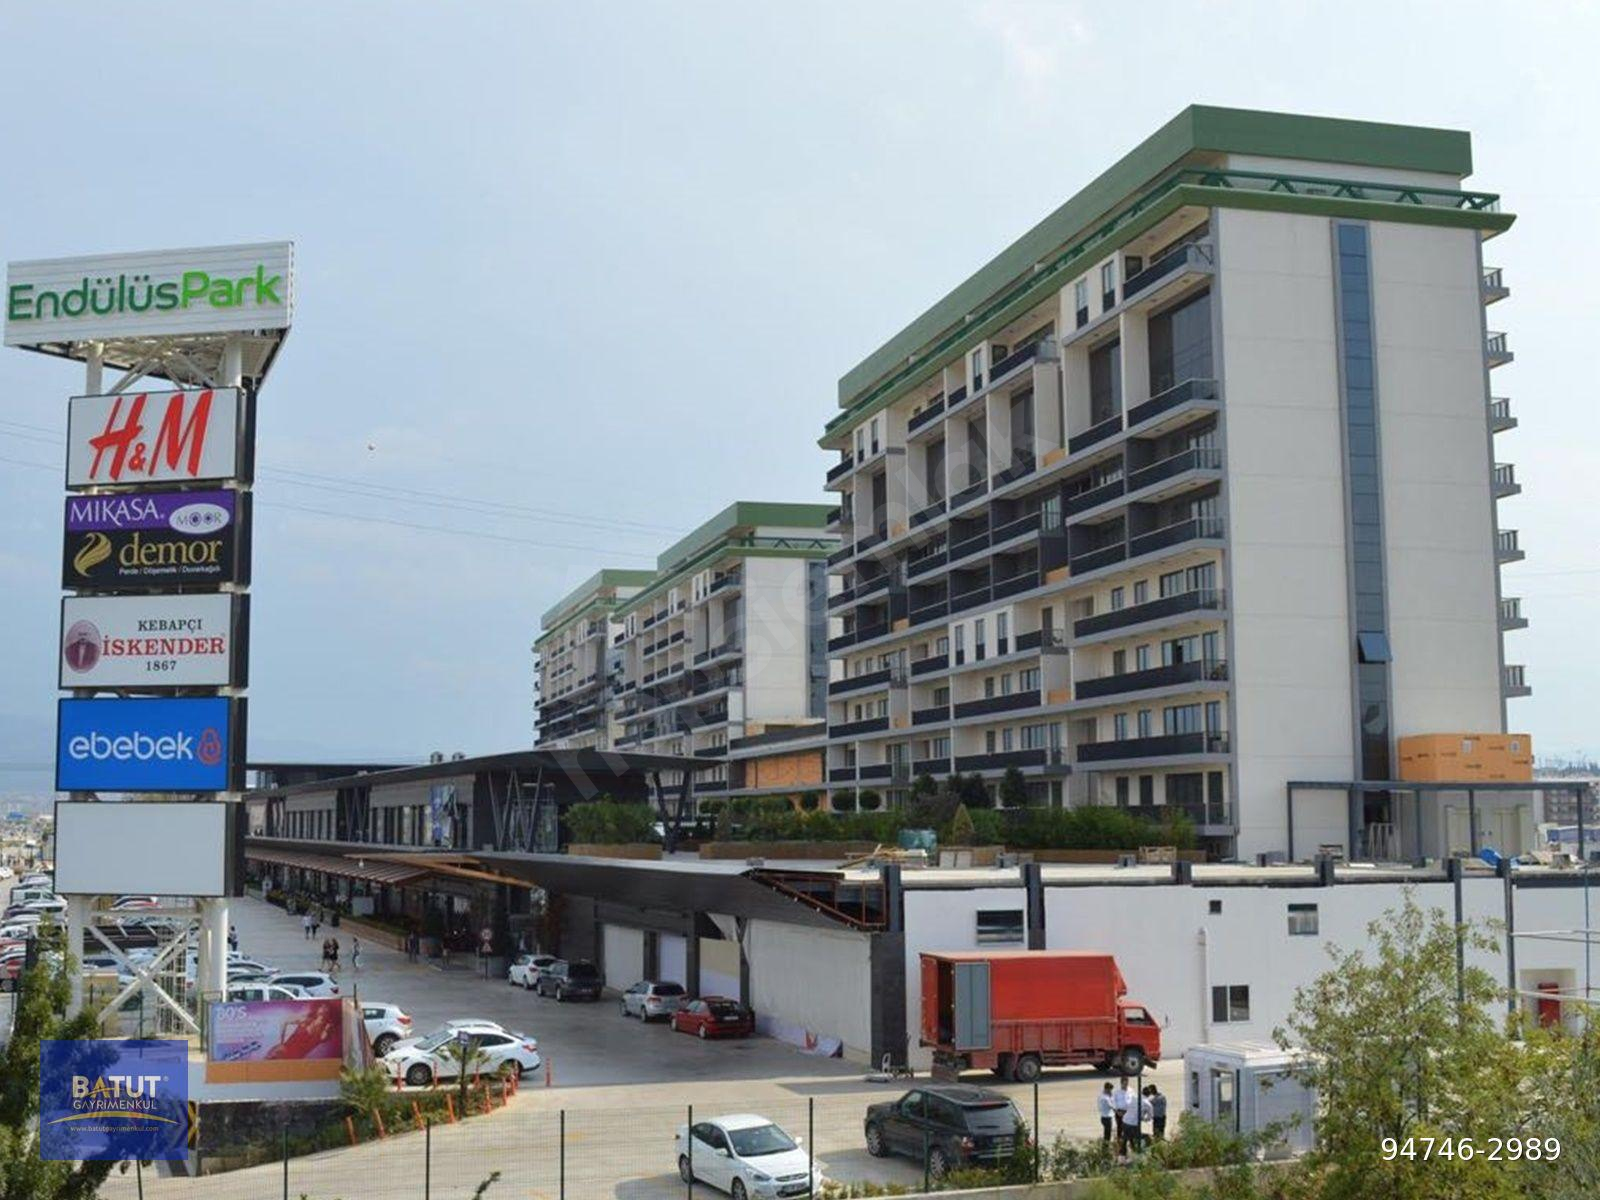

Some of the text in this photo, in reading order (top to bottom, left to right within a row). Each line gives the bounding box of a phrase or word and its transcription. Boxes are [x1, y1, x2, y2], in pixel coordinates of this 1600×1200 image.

[8, 264, 281, 320] EndülüsPark
[89, 389, 214, 480] H&M
[119, 531, 224, 566] demor
[138, 618, 202, 633] KEBAPÇI
[102, 635, 225, 657] İSKENDER
[146, 660, 177, 671] 1867
[69, 731, 194, 760] ebebek
